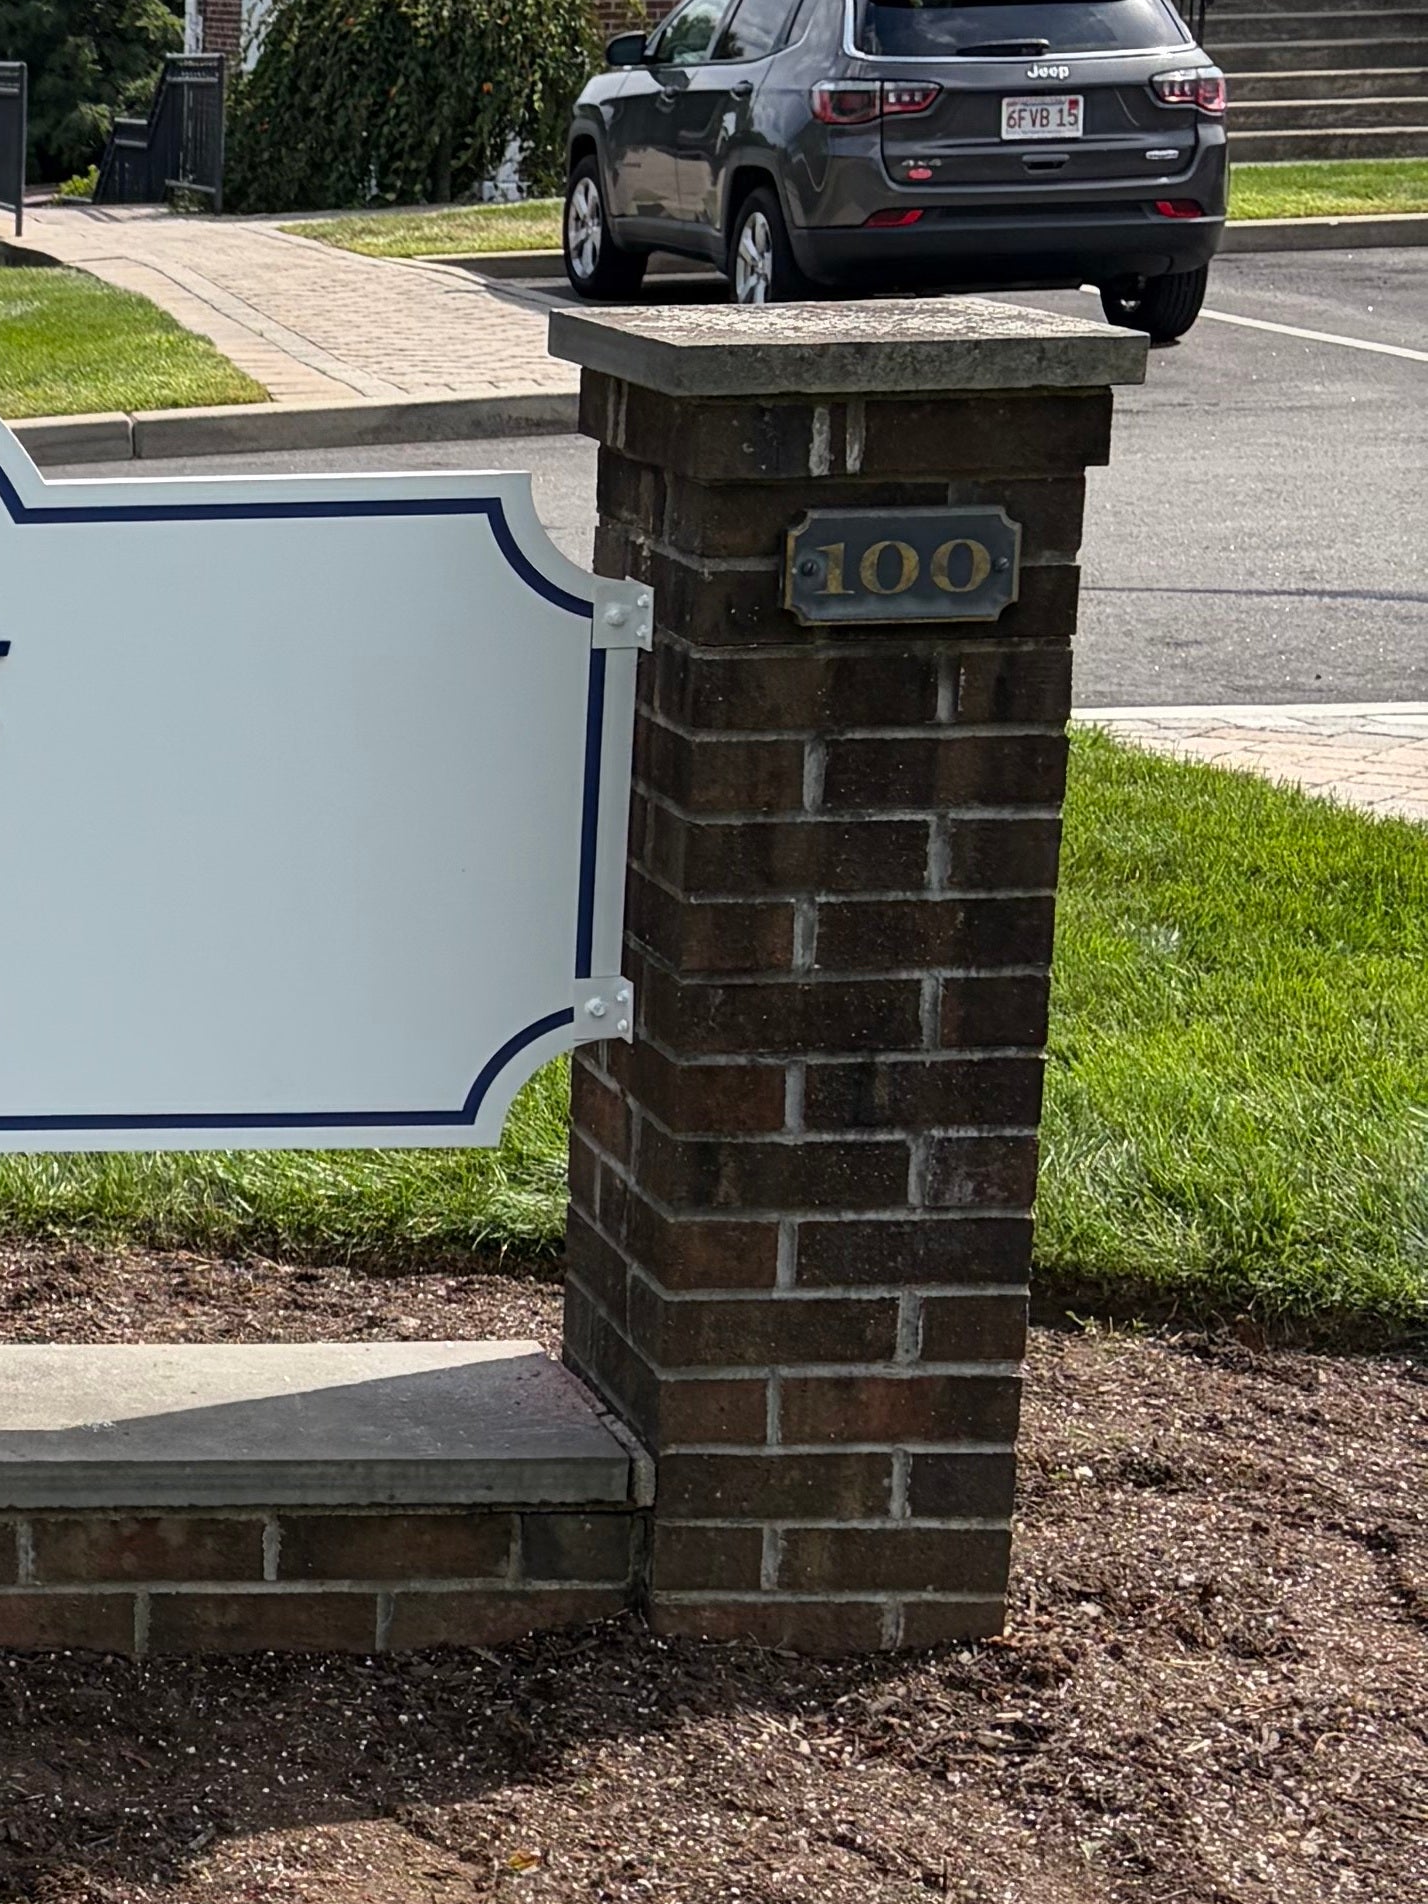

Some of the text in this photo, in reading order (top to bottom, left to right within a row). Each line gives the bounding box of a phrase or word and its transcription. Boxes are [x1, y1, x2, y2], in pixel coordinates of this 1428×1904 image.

[1027, 64, 1070, 80] Jeep
[1006, 106, 1079, 129] 6FVB 15
[812, 538, 991, 595] 100
